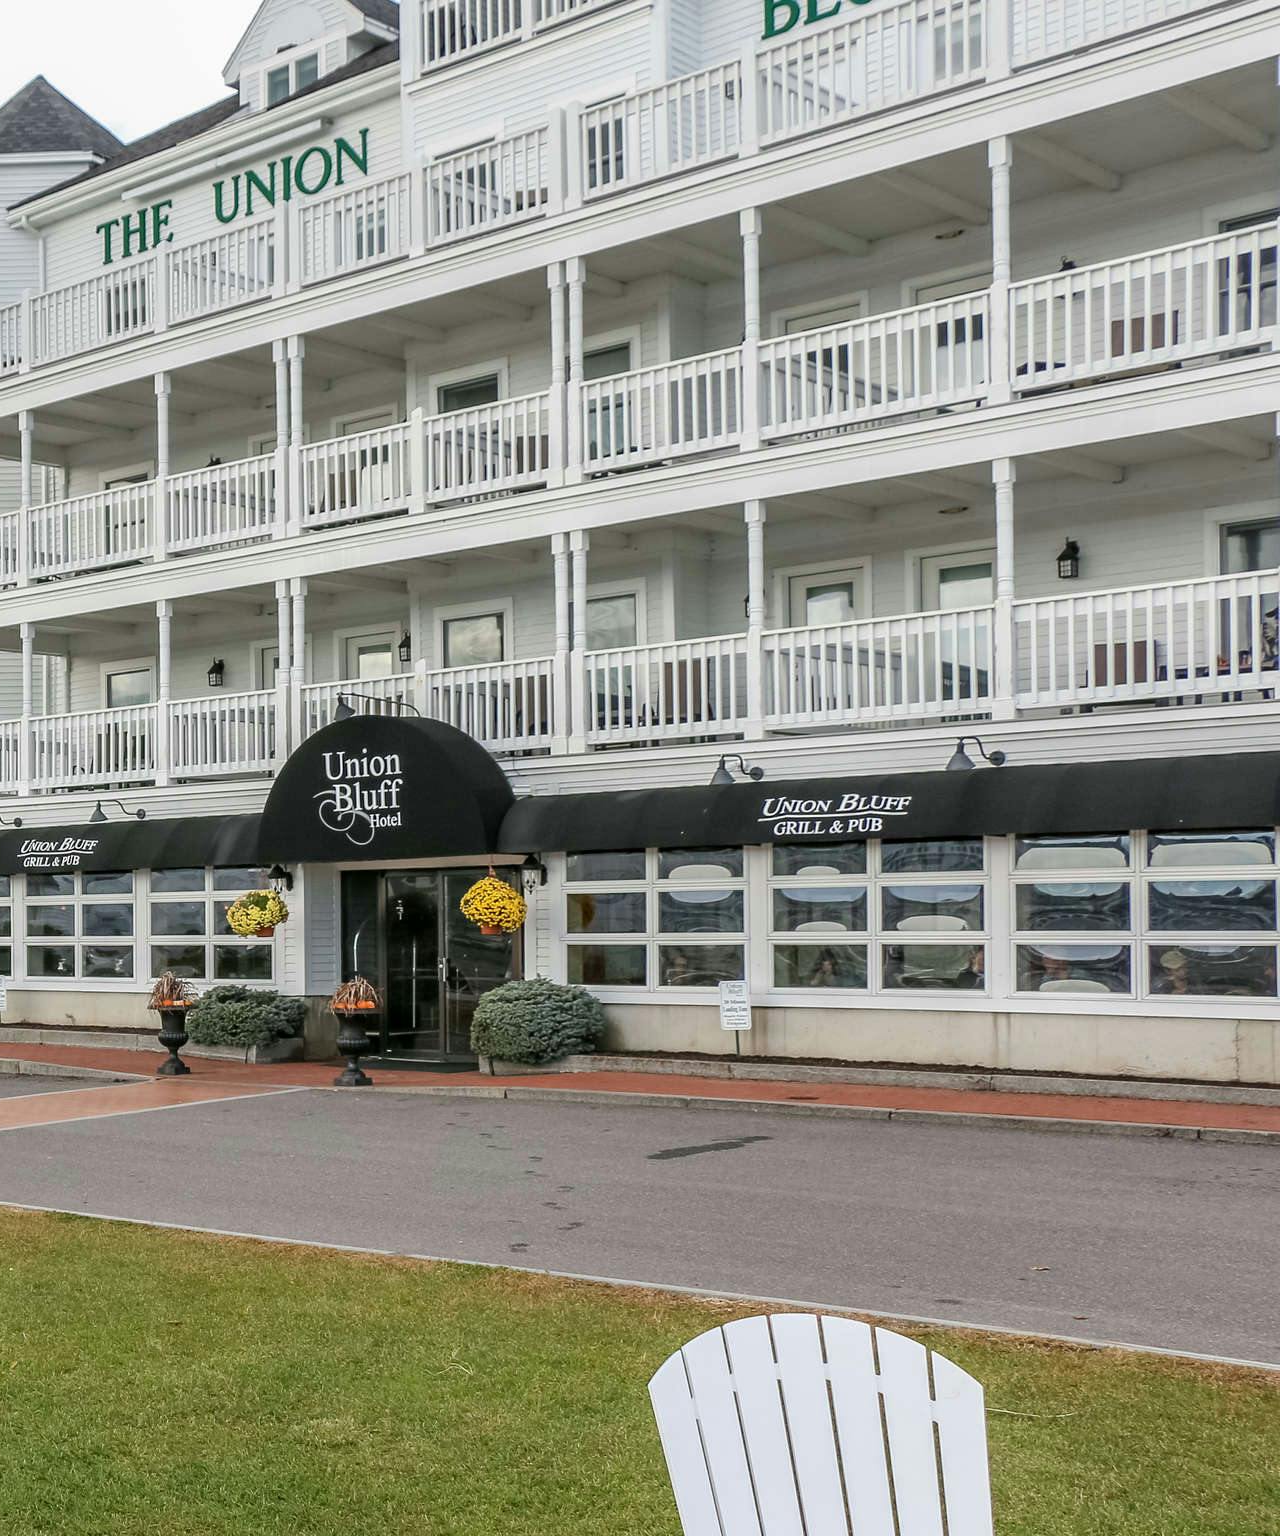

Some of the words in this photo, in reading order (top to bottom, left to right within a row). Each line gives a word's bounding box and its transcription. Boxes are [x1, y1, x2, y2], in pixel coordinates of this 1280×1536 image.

[95, 199, 175, 266] THE
[212, 127, 370, 225] UNION
[322, 747, 403, 780] Union
[332, 778, 404, 812] Bluff
[762, 796, 833, 817] UNION
[836, 793, 913, 812] BLUFF
[369, 811, 403, 828] Hotel
[773, 820, 825, 836] GRILL
[829, 819, 844, 834] &
[847, 817, 884, 833] PUB
[23, 856, 51, 868] GRILL
[52, 856, 60, 867] &
[61, 854, 81, 866] PUB
